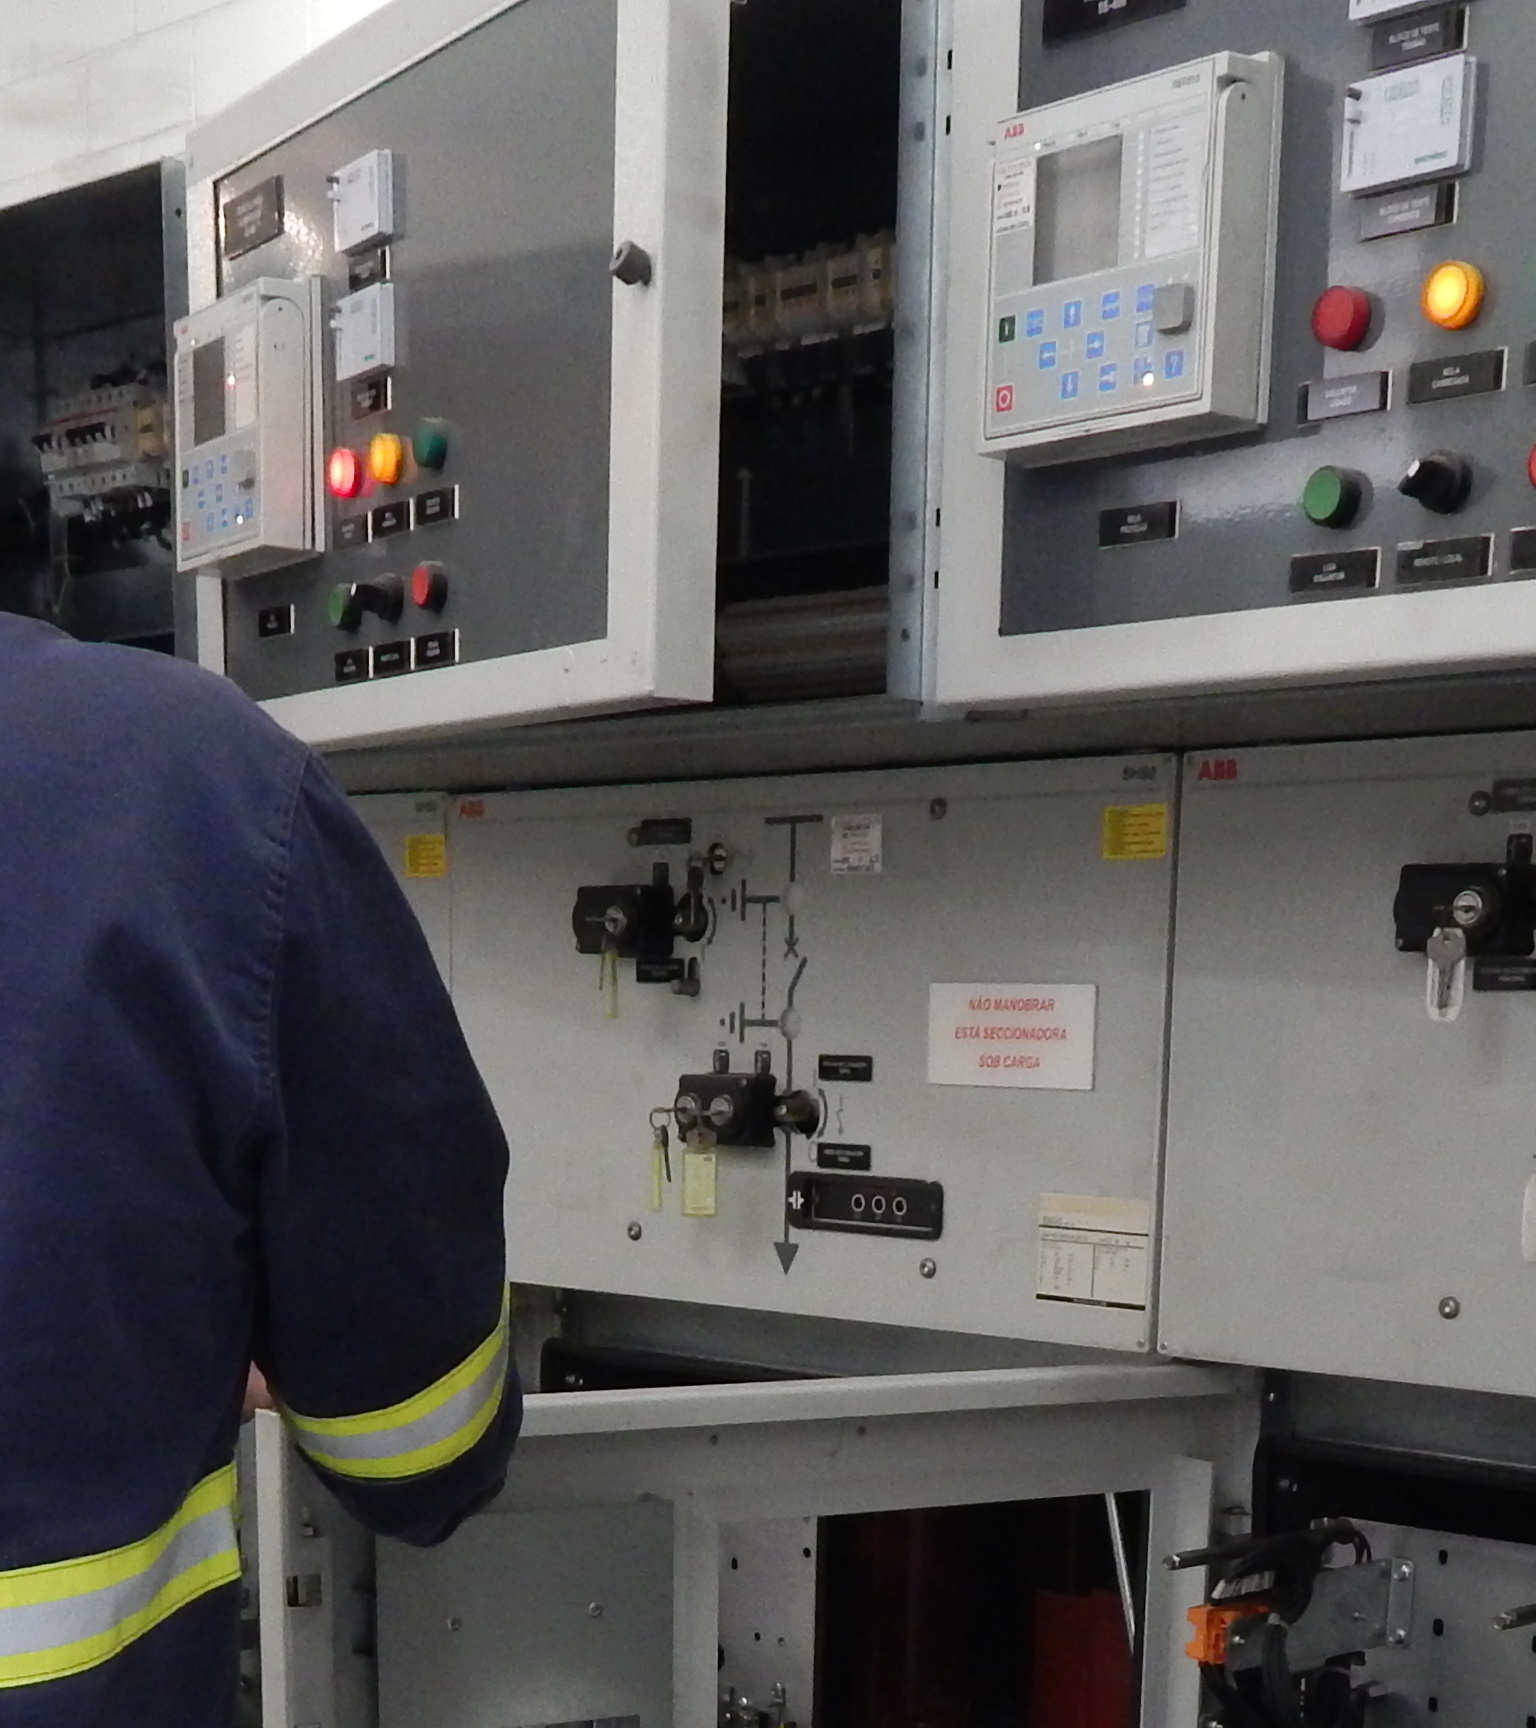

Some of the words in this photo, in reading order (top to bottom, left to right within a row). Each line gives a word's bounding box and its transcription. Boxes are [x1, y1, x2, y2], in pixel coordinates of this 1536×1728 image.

[1196, 758, 1238, 781] ABB
[992, 997, 1056, 1012] MANOBRAR
[982, 1026, 1068, 1041] SECCIONADORA
[977, 1054, 1001, 1069] SOB
[1002, 1055, 1041, 1070] CARGA
